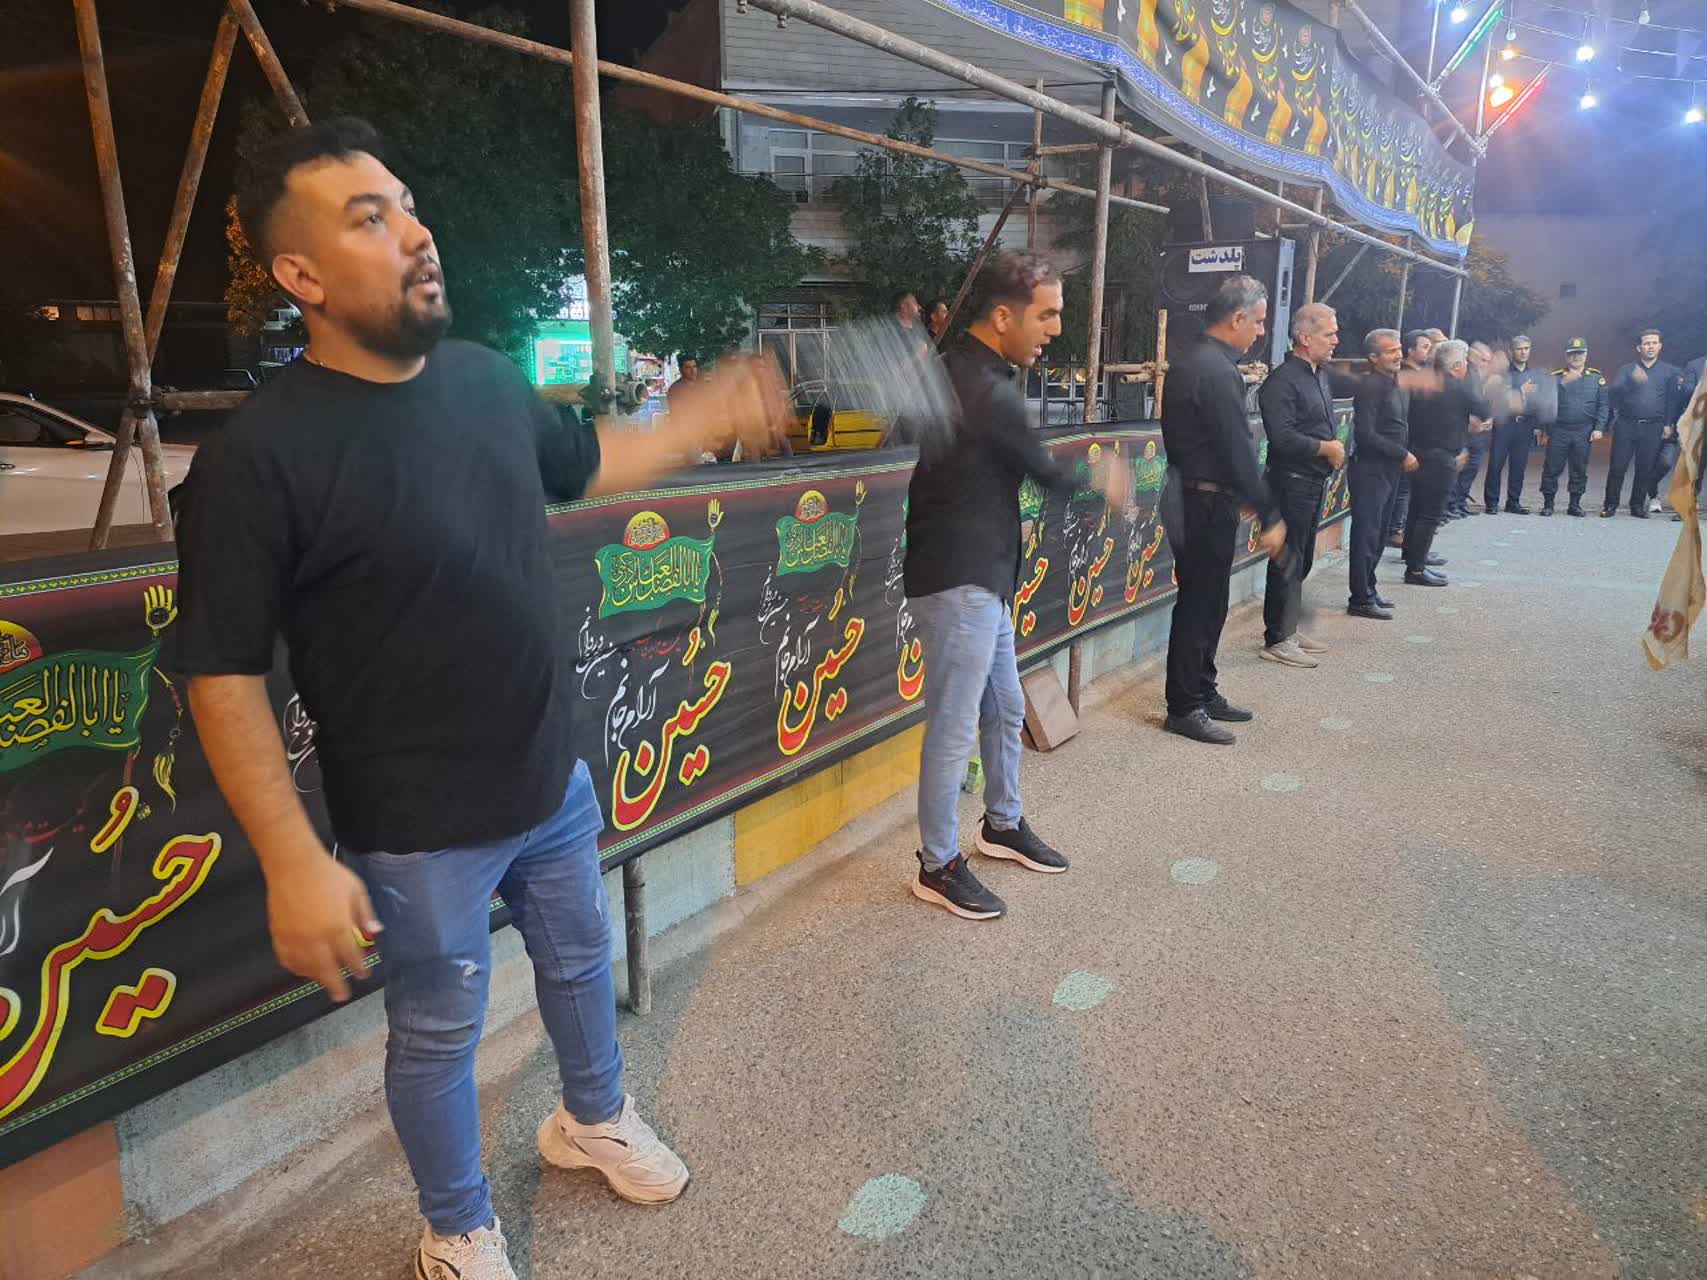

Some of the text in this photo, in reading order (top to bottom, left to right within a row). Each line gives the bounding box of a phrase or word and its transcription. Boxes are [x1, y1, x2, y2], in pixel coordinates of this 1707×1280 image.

[1191, 247, 1241, 271] پلدشت
[1012, 557, 1049, 637] حسی
[1068, 537, 1115, 626] حسین
[604, 657, 670, 769] آرام جانم
[776, 617, 866, 756] حسین
[612, 660, 732, 832] حسین
